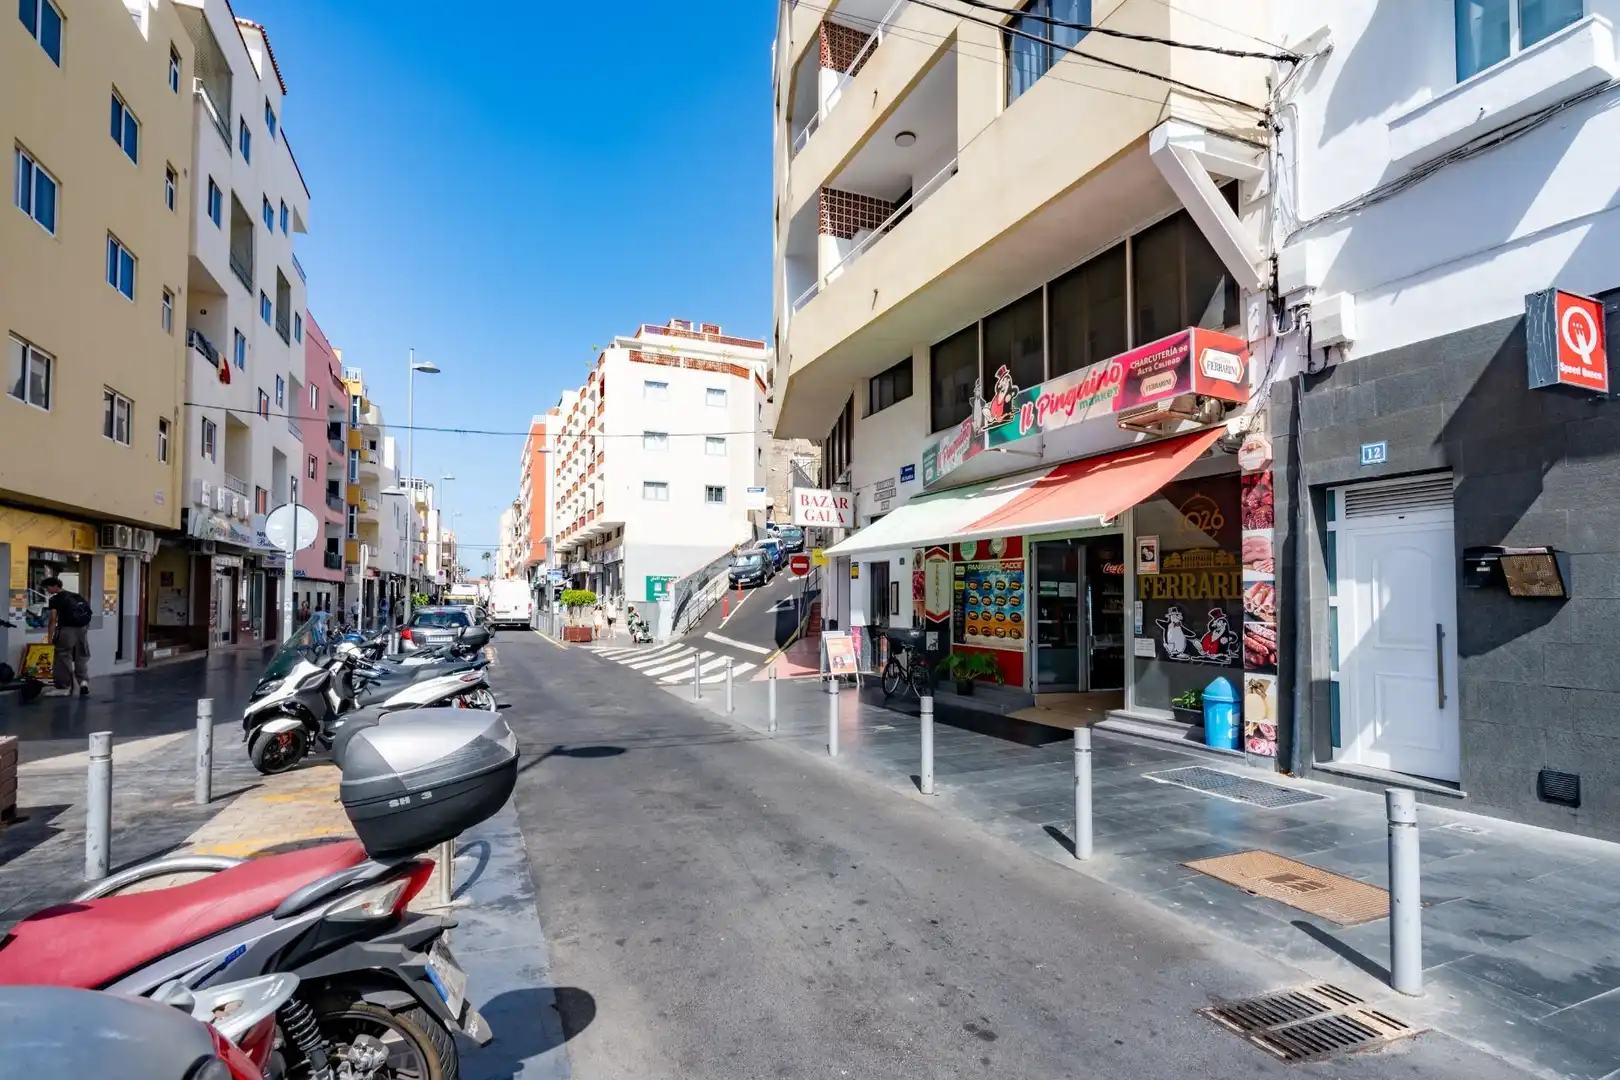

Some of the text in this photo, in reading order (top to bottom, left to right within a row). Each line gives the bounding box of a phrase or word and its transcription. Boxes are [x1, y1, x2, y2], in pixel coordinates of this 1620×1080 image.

[1130, 346, 1178, 369] CHARCUTERÍA
[1560, 361, 1603, 381] Speed Queen
[1036, 364, 1122, 426] Pinguino
[1367, 447, 1380, 460] 12
[800, 494, 848, 509] BAZAR
[804, 509, 844, 523] GALA
[388, 796, 411, 808] SH
